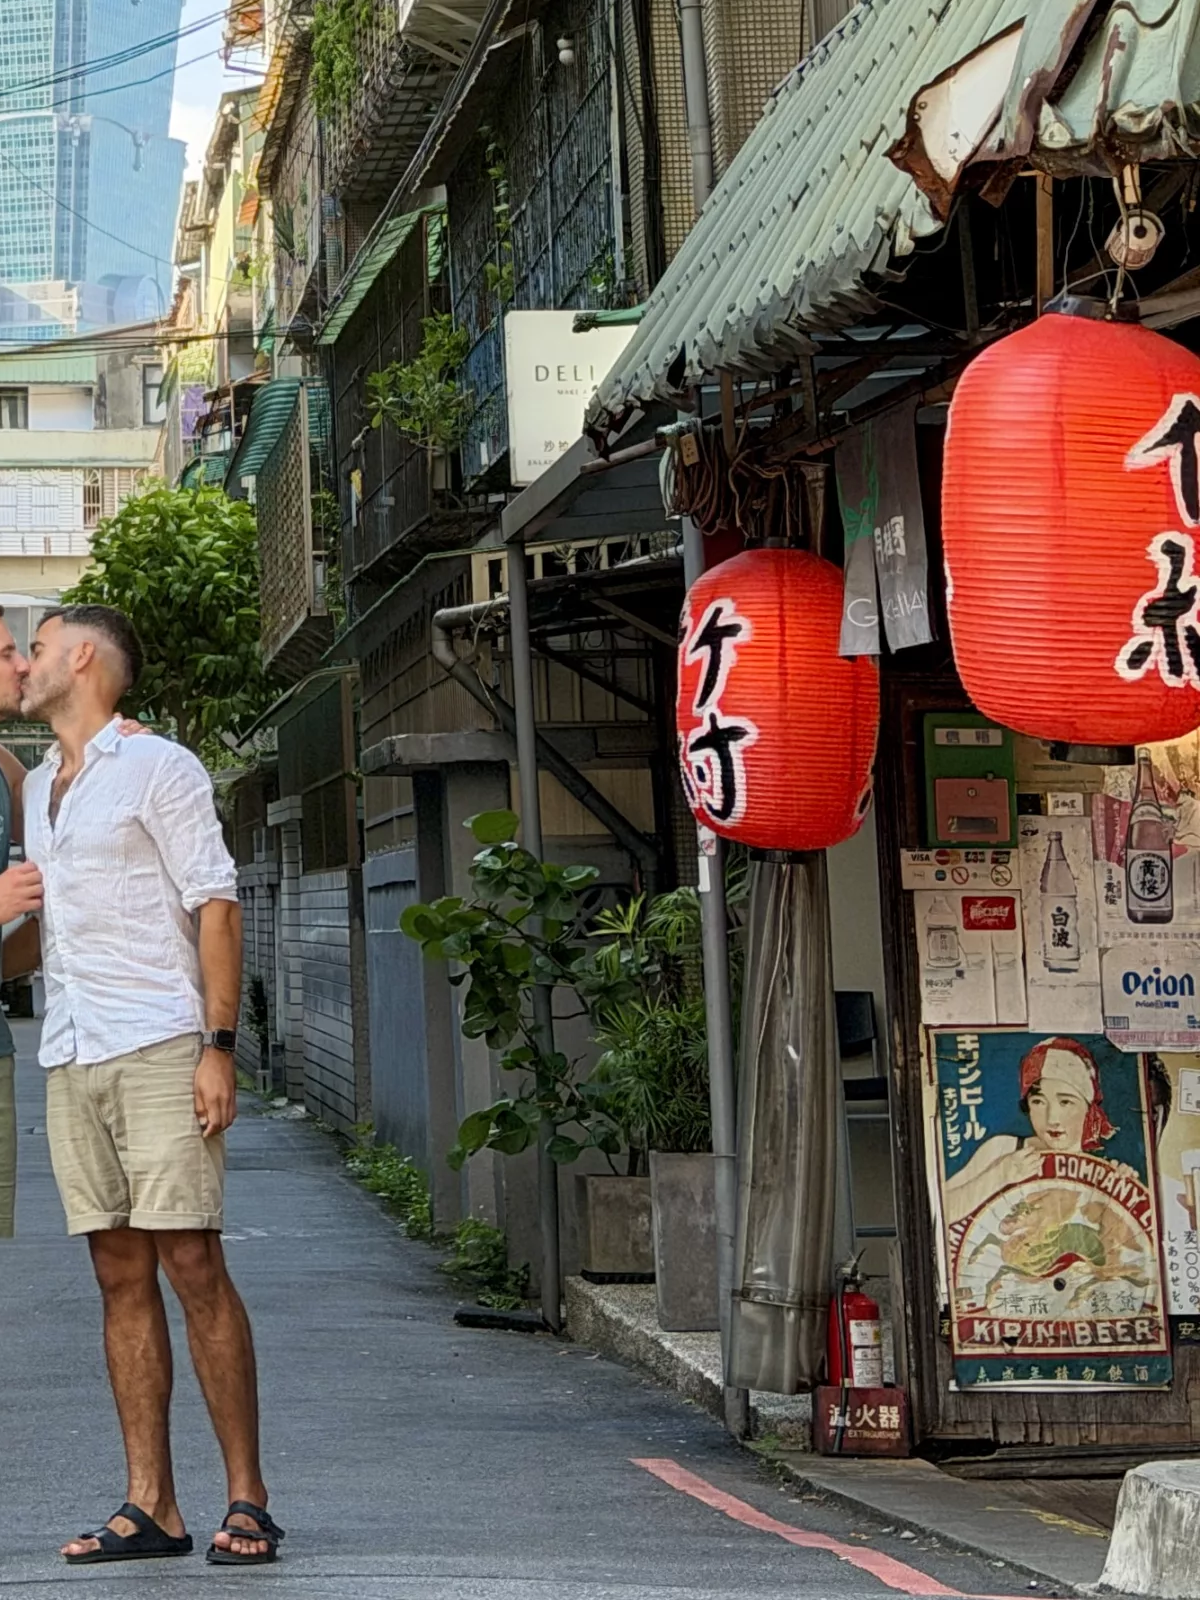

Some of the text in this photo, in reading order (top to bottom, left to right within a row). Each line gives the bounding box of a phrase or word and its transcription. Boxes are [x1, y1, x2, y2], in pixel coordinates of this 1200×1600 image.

[911, 853, 931, 862] VISA
[1051, 906, 1072, 949] 白波
[1122, 966, 1195, 997] Orion
